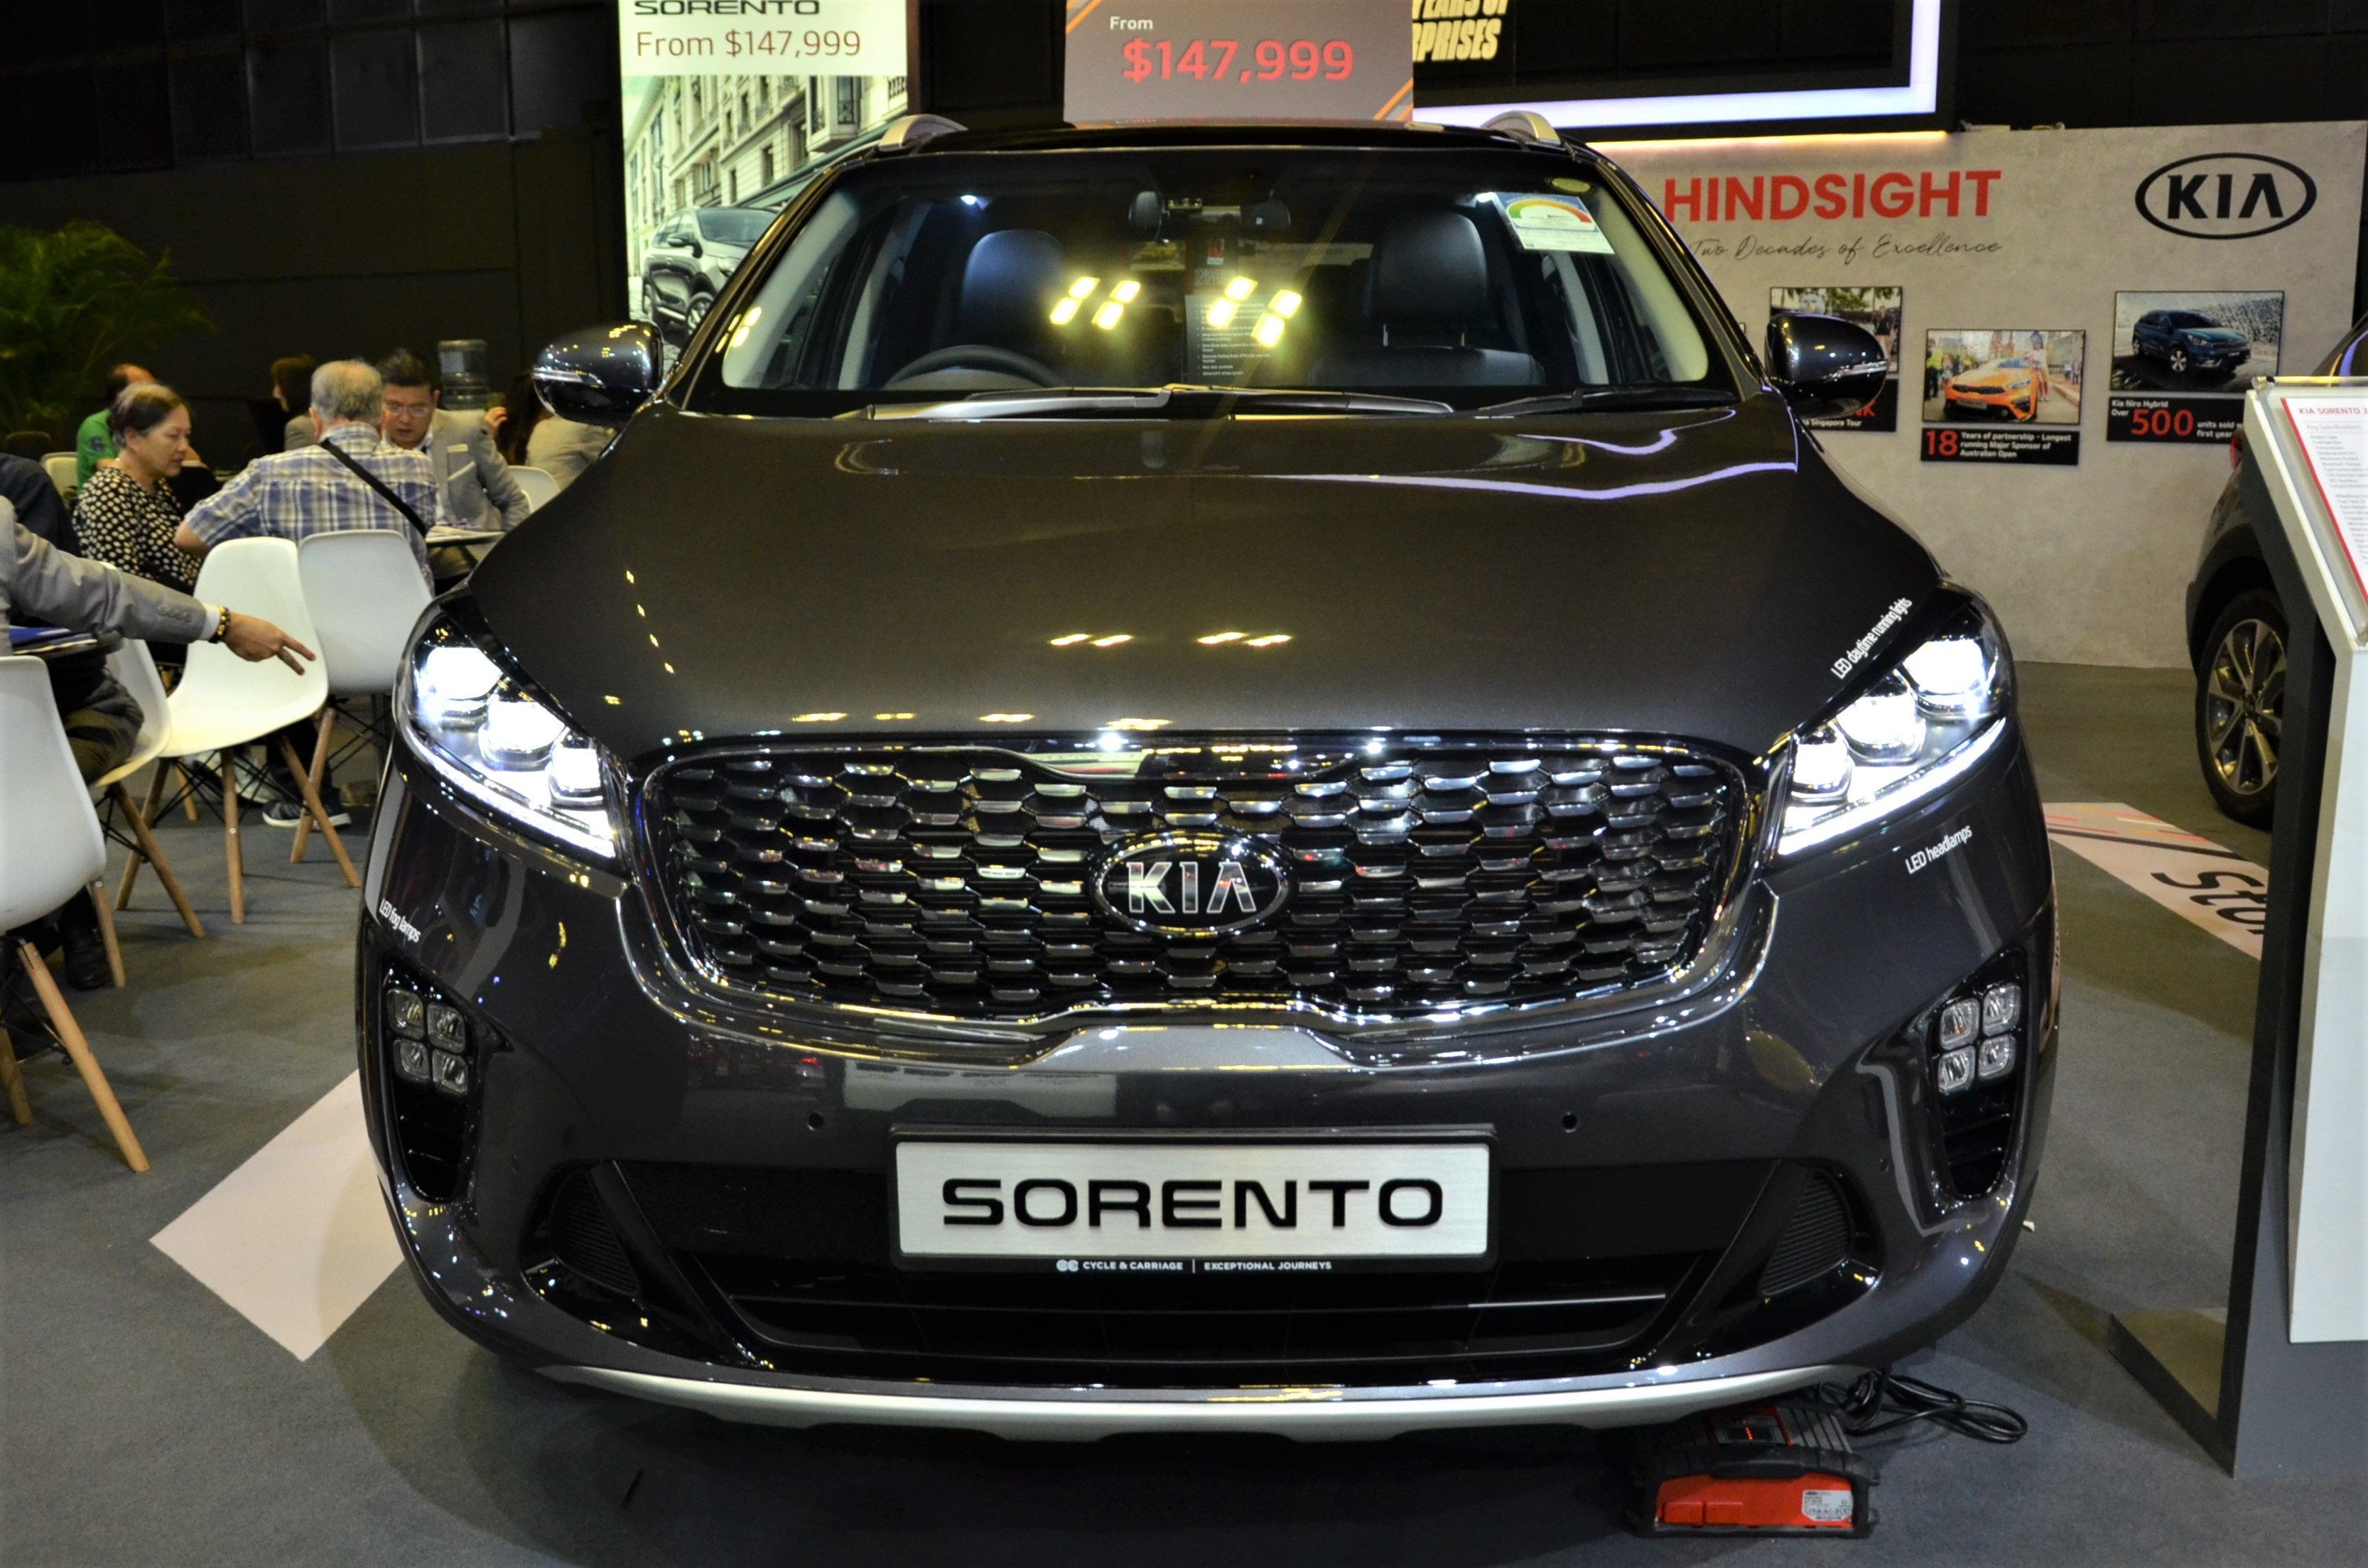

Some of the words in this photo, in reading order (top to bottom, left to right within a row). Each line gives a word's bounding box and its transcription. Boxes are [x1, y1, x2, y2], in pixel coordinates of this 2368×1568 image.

[634, 0, 821, 15] SORENTO
[1110, 16, 1154, 31] From
[637, 31, 714, 56] From
[725, 29, 861, 58] $147,999
[1121, 37, 1354, 84] $147,999
[1665, 170, 2001, 222] HINDSIGHT
[2166, 173, 2283, 220] KIA
[1734, 234, 1829, 260] Decades
[1838, 236, 1864, 266] of
[1872, 232, 2004, 259] Excellence
[2143, 401, 2169, 409] Hybrid
[1811, 418, 1845, 428] Singapore
[2131, 409, 2194, 436] 500
[1926, 430, 1958, 456] 18
[1992, 433, 2035, 441] partnership
[2042, 433, 2072, 442] Longest
[2011, 442, 2041, 450] Sponsor
[1998, 450, 2017, 458] Open
[1830, 657, 1853, 680] LED
[1846, 632, 1878, 664] daytime
[1871, 610, 1903, 637] running
[1888, 597, 1913, 616] lights
[1905, 850, 1927, 875] LED
[1925, 825, 1972, 862] headlamps
[1126, 862, 1257, 914] KIA
[379, 898, 392, 919] LED
[388, 907, 401, 930] fog
[398, 915, 421, 943] lamps
[941, 1177, 1444, 1229] SORENTO
[1083, 1261, 1117, 1270] CYCLE
[1119, 1261, 1128, 1270] &
[1130, 1261, 1184, 1270] CARRIAGE
[1204, 1261, 1275, 1270] EXCEPTIONAL
[1277, 1261, 1331, 1270] JOURNEYS
